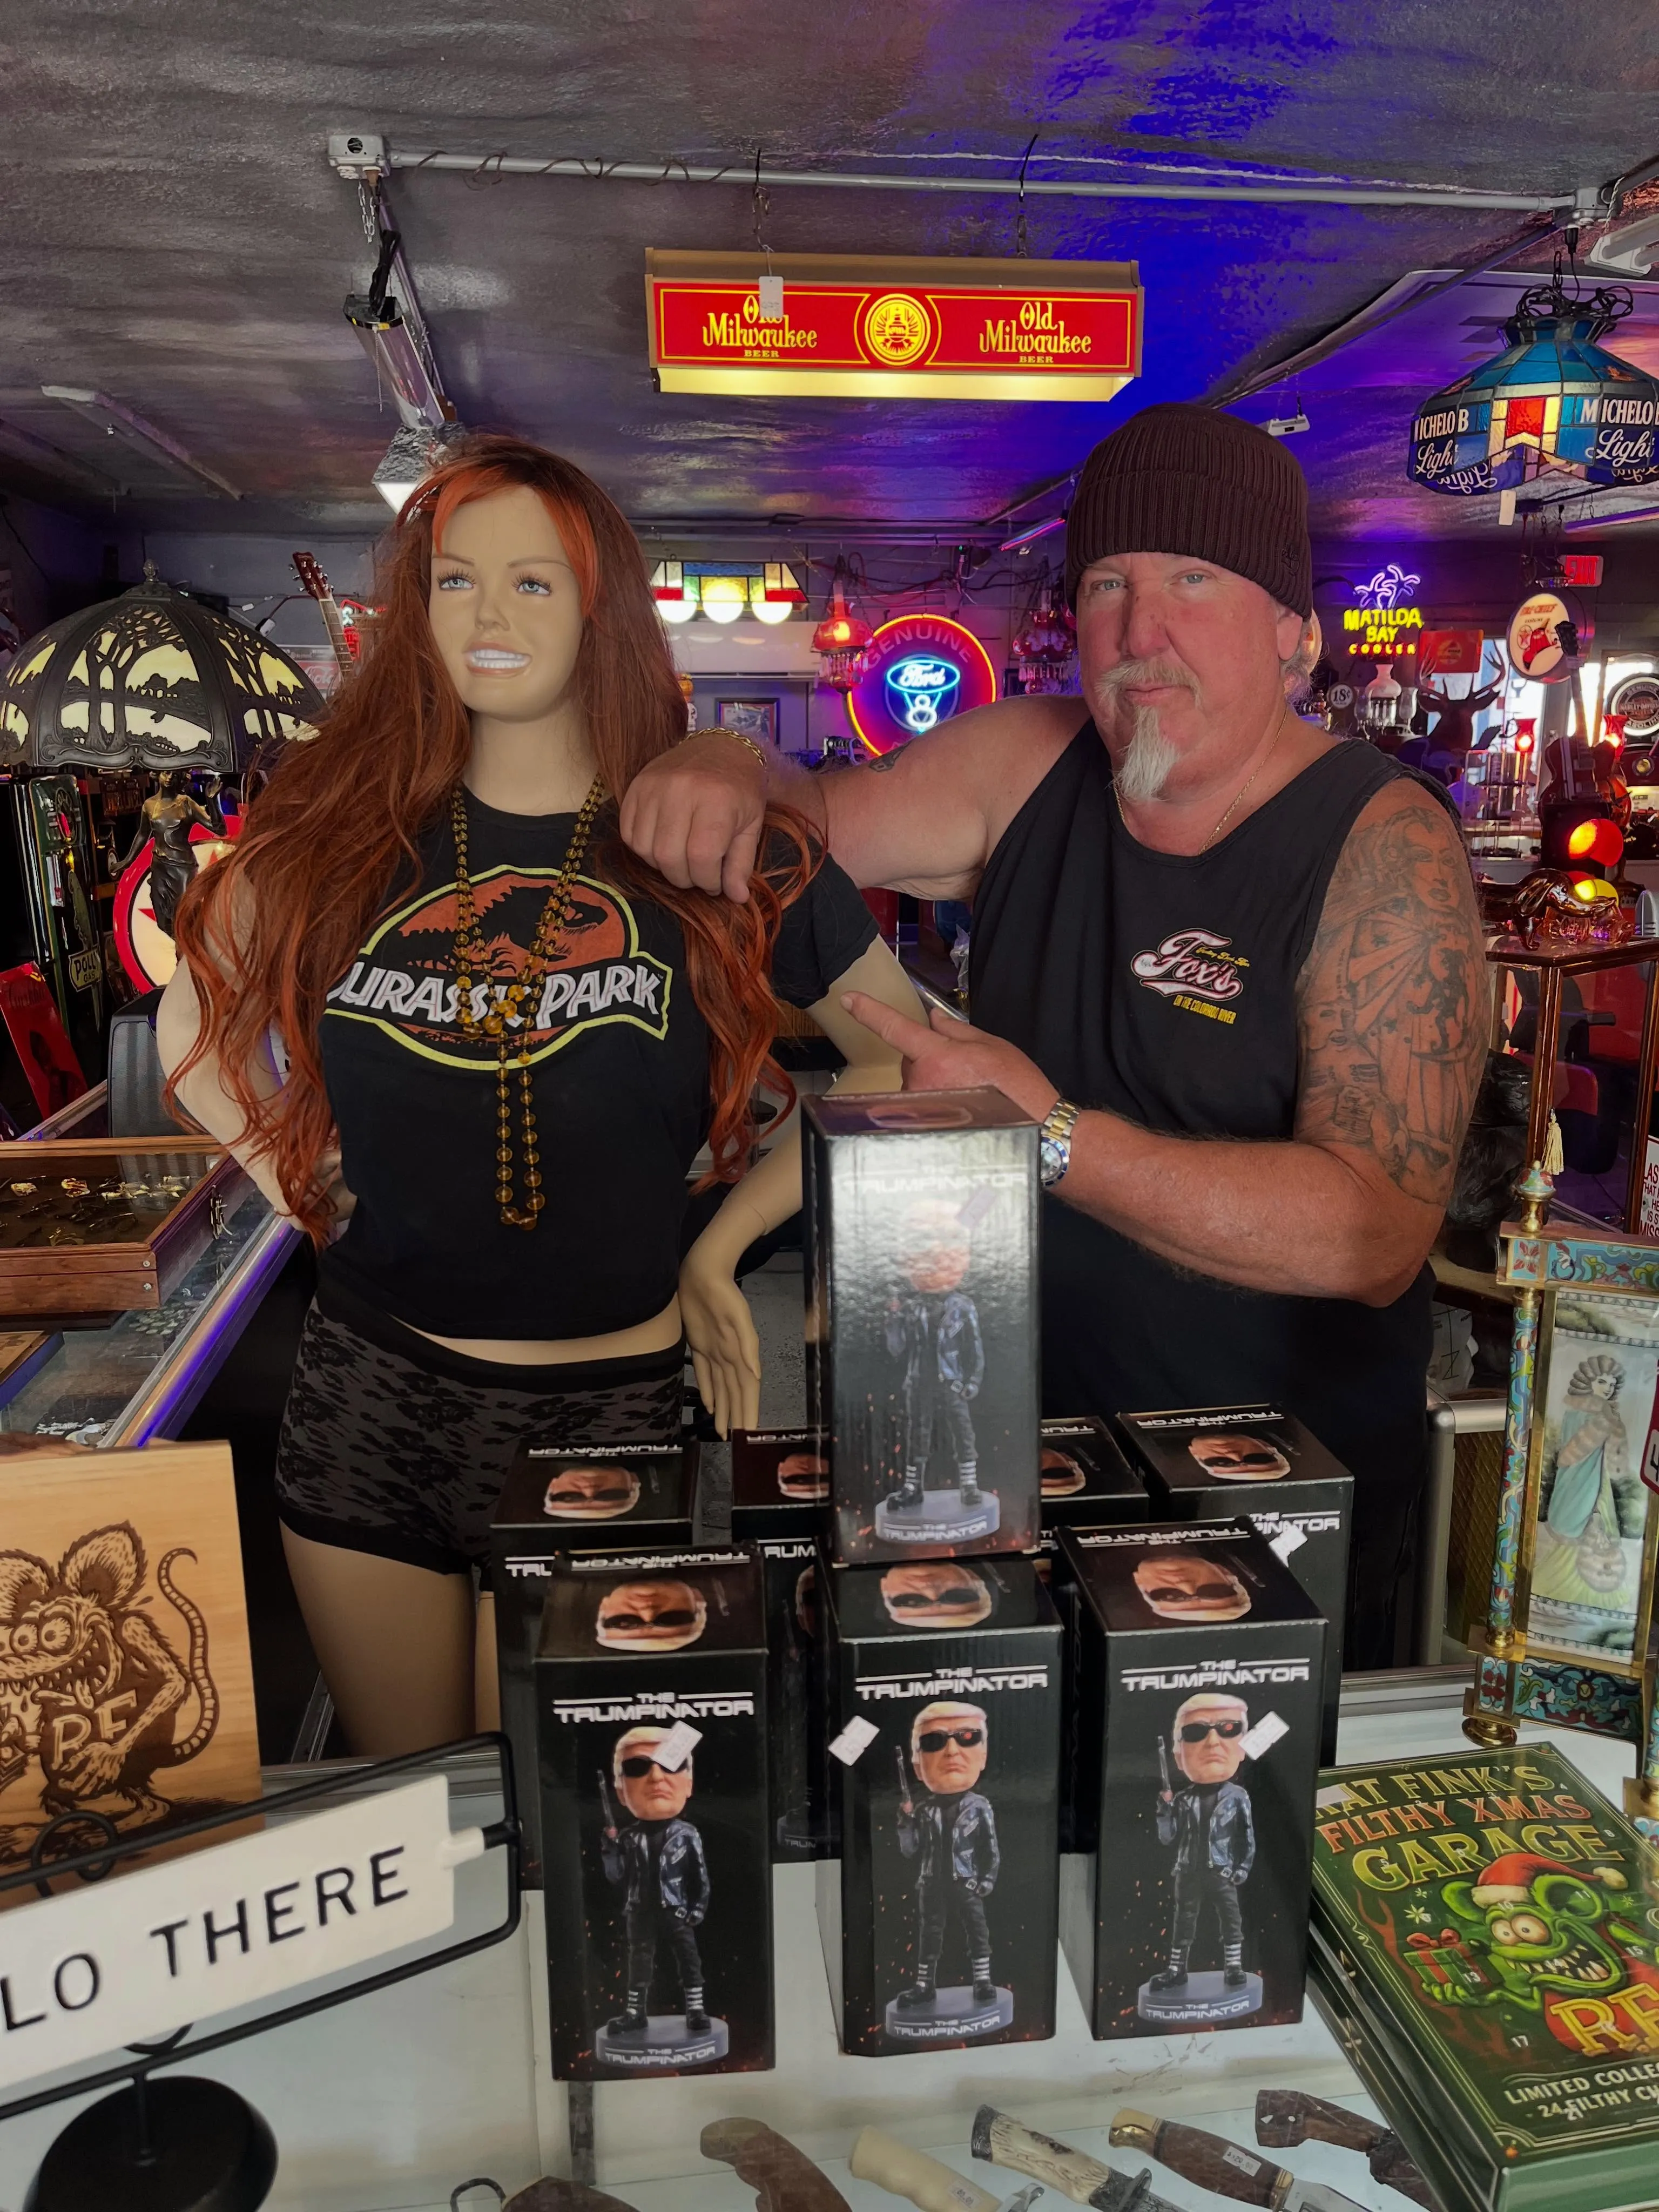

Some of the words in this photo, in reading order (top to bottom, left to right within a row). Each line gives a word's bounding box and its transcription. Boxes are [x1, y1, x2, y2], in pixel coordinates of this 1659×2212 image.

[1020, 302, 1058, 330] Old
[702, 312, 817, 348] Milwaukee
[980, 319, 1091, 354] Milwaukee
[744, 349, 779, 358] BEER
[1565, 555, 1598, 584] EXIT
[1344, 607, 1424, 631] MATILDA
[1366, 625, 1399, 642] BAY
[867, 624, 973, 671] GENUINE
[1349, 643, 1417, 655] COOLER
[900, 664, 946, 687] Ford
[1131, 928, 1243, 1000] Fox's
[536, 965, 660, 1030] PARK
[1137, 1411, 1282, 1426] TRUMPINATOR
[528, 1444, 683, 1455] TRUMPINATOR
[1249, 1512, 1279, 1522] THE
[884, 1521, 987, 1541] TRUMPINATOR
[1077, 1528, 1248, 1544] TRUMPINATOR
[572, 1552, 750, 1568] TRUMPINATOR
[935, 1667, 973, 1678] THE
[1200, 1660, 1237, 1671] THE
[855, 1673, 1048, 1701] TRUMPINATOR
[1121, 1666, 1310, 1692] TRUMPINATOR
[636, 1692, 676, 1703] THE
[553, 1700, 754, 1723] TRUMPINATOR
[1389, 1765, 1555, 1799] FINK'S
[1315, 1800, 1456, 1854] FILTHY
[1455, 1795, 1591, 1823] XMAS
[1352, 1824, 1626, 1891] GARAGE
[151, 1846, 410, 1978] THERE
[1625, 1945, 1644, 1956] 15
[1464, 1972, 1481, 1982] 13
[1146, 2000, 1249, 2020] TRUMPINATOR
[894, 2016, 1000, 2037] TRUMPINATOR
[1511, 2035, 1529, 2048] 17
[605, 2045, 716, 2065] TRUMPINATOR
[1503, 2077, 1590, 2105] LIMITED
[1537, 2102, 1562, 2118] 24
[1564, 2088, 1632, 2112] FILTHY
